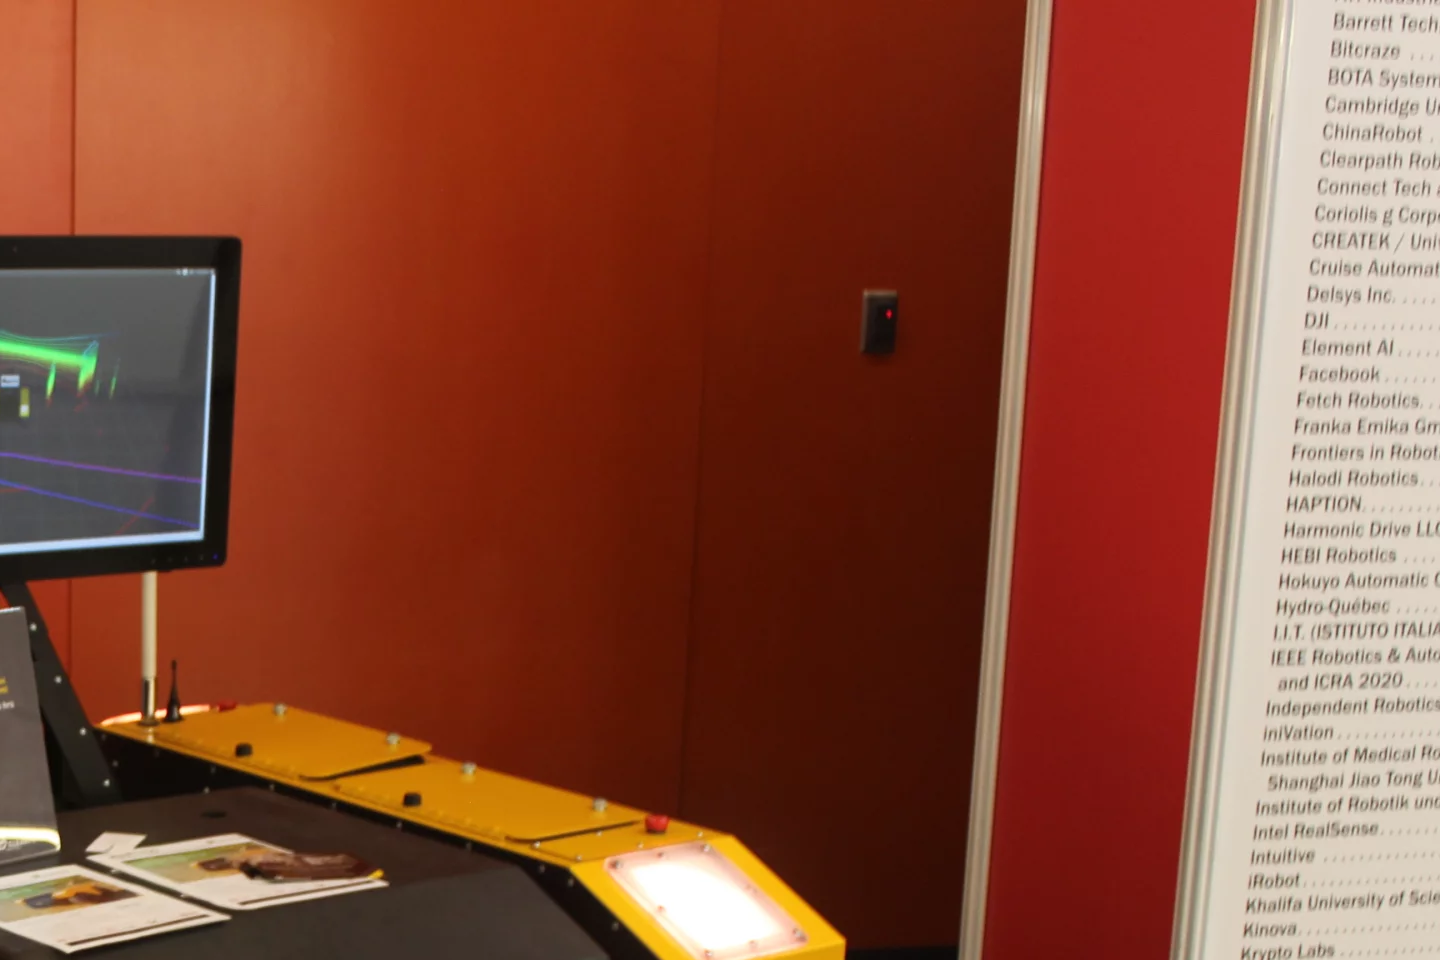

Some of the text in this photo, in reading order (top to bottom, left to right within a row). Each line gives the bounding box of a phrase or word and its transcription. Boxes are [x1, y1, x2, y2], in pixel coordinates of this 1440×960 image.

[1333, 11, 1440, 33] Barrett Tech
[1330, 39, 1401, 60] Bitcraze
[1328, 67, 1373, 87] BOTA
[1325, 94, 1419, 120] Cambridge
[1322, 122, 1422, 142] ChinaRobot
[1320, 149, 1403, 172] Clearpath
[1317, 177, 1387, 197] Connect
[1393, 178, 1431, 197] Tech
[1314, 203, 1377, 223] Coriolis
[1382, 207, 1394, 227] g
[1312, 231, 1390, 250] CREATEK
[1309, 258, 1362, 277] Cruise
[1307, 284, 1362, 307] Delsys
[1304, 311, 1329, 330] DJI
[1301, 337, 1394, 357] Element AI
[1299, 364, 1380, 383] Facebook
[1296, 391, 1420, 410] Fetch Robotics
[1294, 417, 1351, 435] Franka
[1357, 417, 1409, 435] Emika
[1291, 443, 1440, 461] Frontiers in Robot
[1288, 468, 1419, 488] Halodi Robotics
[1286, 495, 1362, 513] HAPTION
[1284, 520, 1365, 539] Harmonic
[1369, 520, 1411, 538] Drive
[1281, 545, 1397, 564] HEBI Robotics
[1278, 573, 1340, 593] Hokuyo
[1345, 572, 1429, 590] Automatic
[1310, 622, 1389, 643] (ISTITUTO
[1271, 649, 1307, 667] IEEE
[1312, 647, 1382, 666] Robotics
[1388, 647, 1401, 665] &
[1277, 671, 1404, 692] and ICRA 2020
[1265, 698, 1369, 719] Independent
[1260, 748, 1327, 767] Institute
[1333, 746, 1349, 764] of
[1353, 744, 1416, 763] Medical
[1267, 771, 1345, 793] Shanghai
[1349, 771, 1381, 789] Jiao
[1386, 769, 1423, 789] Tong
[1255, 799, 1322, 817] Institute
[1327, 796, 1343, 813] of
[1348, 795, 1409, 813] Robotik
[1253, 820, 1379, 841] Intel RealSense
[1250, 848, 1315, 866] Intuitive
[1247, 872, 1300, 890] iRobot
[1245, 896, 1302, 915] Khalifa
[1308, 893, 1384, 913] University
[1389, 890, 1405, 907] of
[1243, 921, 1297, 939] Kinova
[1297, 941, 1335, 960] Labs
